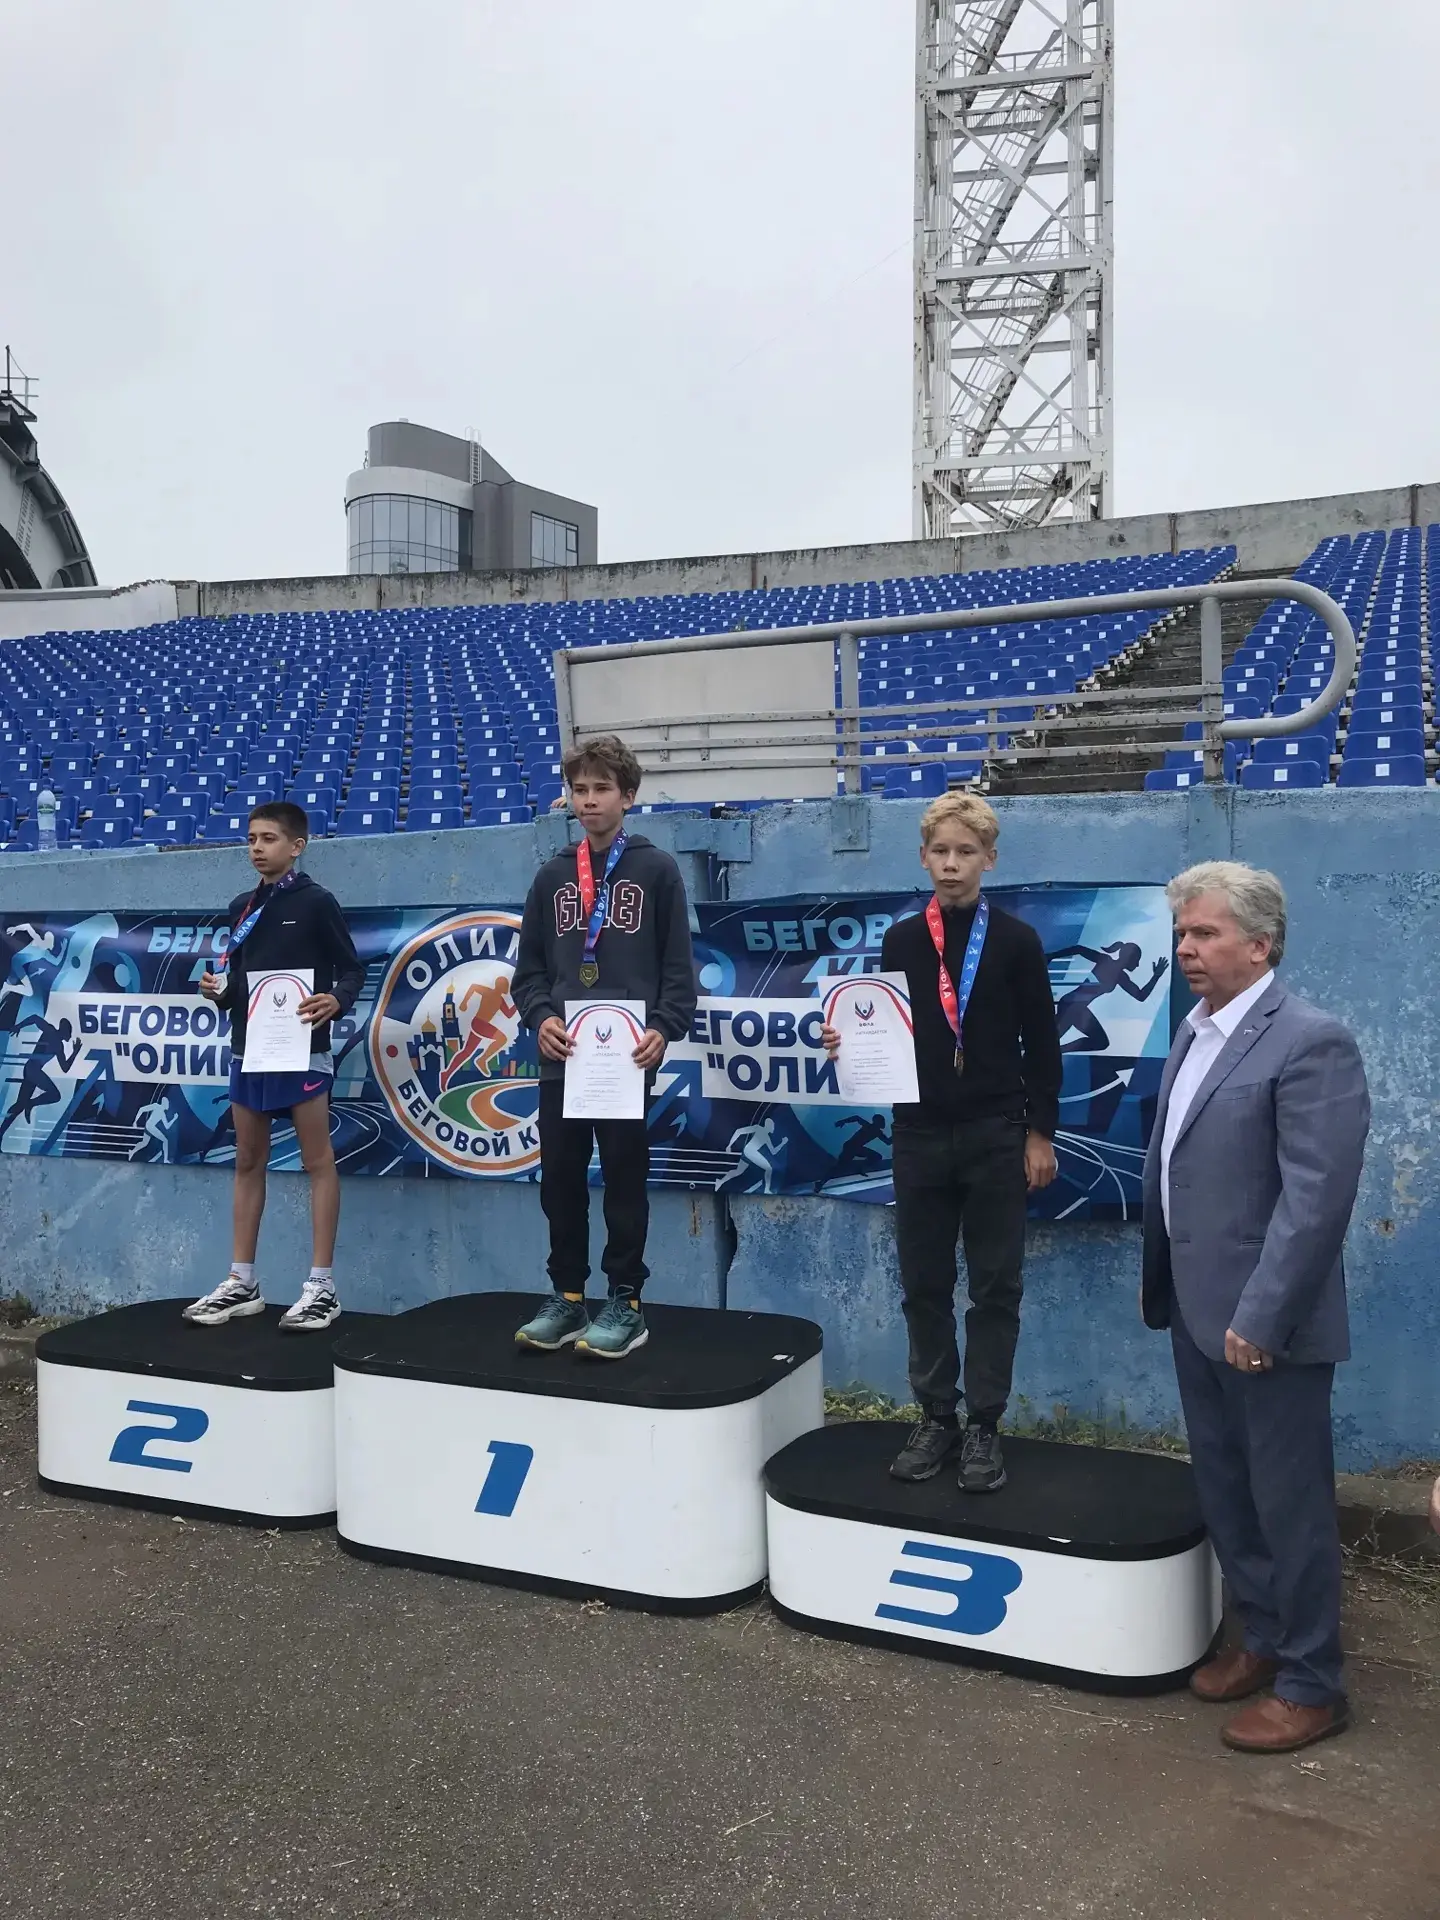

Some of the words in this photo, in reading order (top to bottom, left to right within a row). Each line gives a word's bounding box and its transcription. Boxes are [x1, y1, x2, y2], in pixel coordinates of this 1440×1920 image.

[147, 926, 231, 953] БЕГО
[743, 910, 911, 951] БЕГОВ
[688, 1009, 826, 1049] ЕГОВО
[706, 1052, 841, 1094] "ОЛИ
[397, 1079, 511, 1157] БЕГОВОЙ
[517, 1120, 541, 1151] К
[108, 1399, 210, 1474] 2
[474, 1440, 534, 1517] 1
[874, 1540, 1024, 1636] 3
